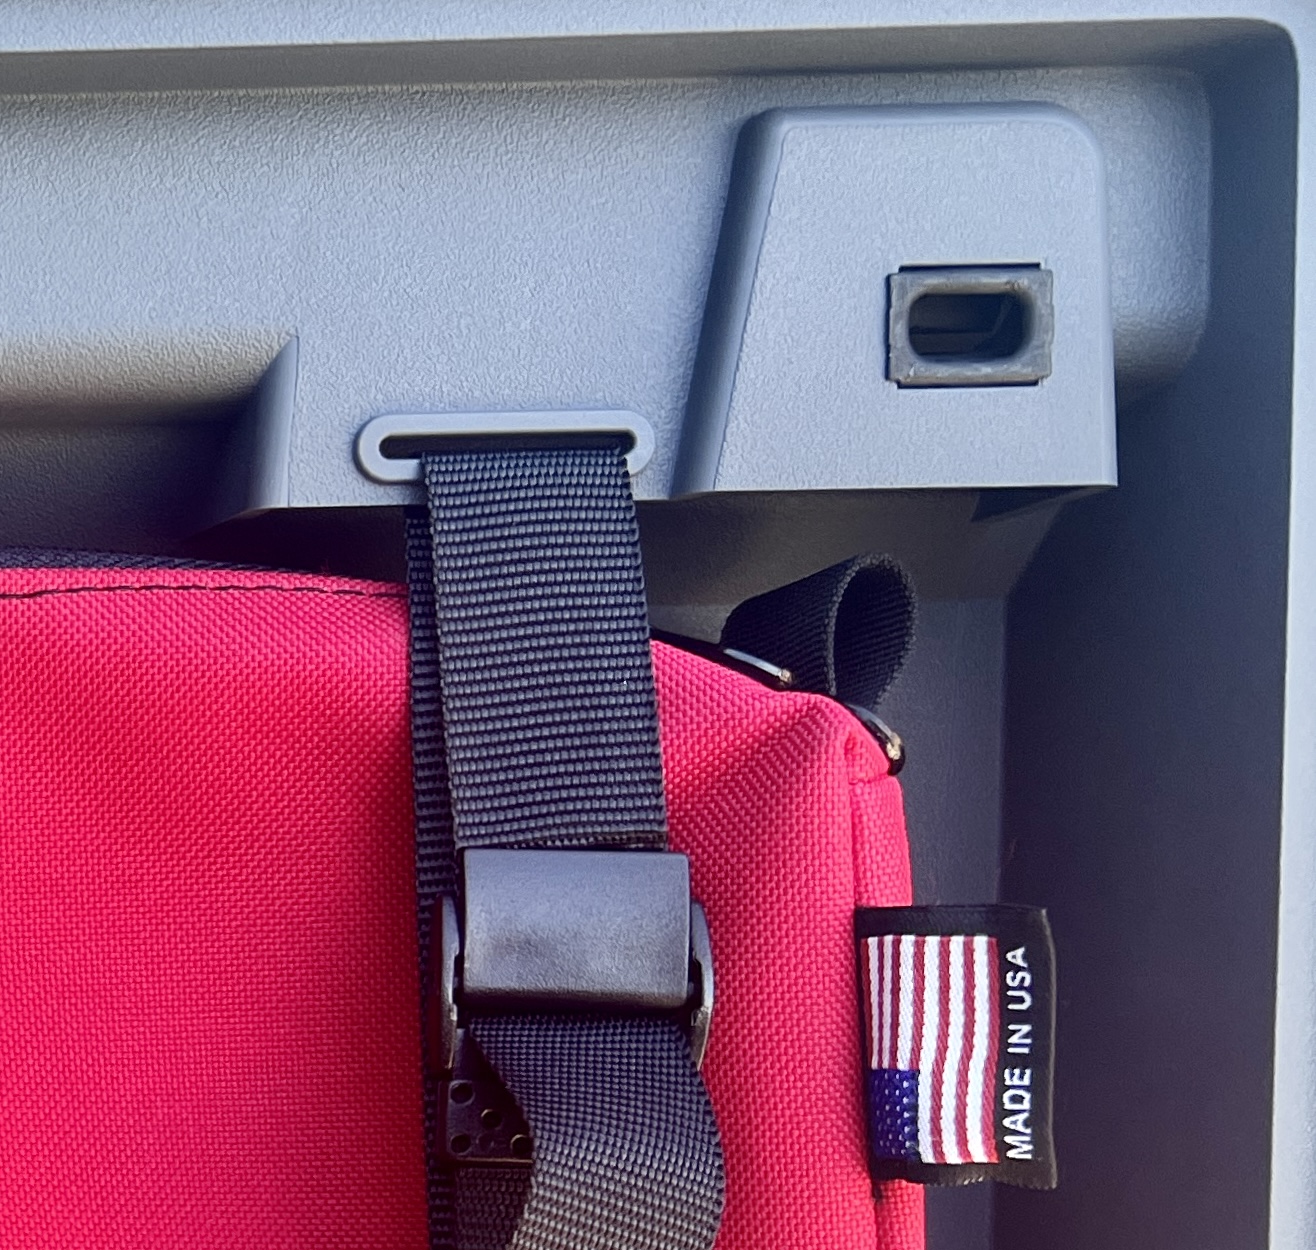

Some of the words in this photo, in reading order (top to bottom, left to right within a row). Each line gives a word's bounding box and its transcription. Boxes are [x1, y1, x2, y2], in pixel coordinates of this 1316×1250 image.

[1005, 946, 1033, 1011] USA
[1006, 1024, 1033, 1054] IN
[1002, 1068, 1033, 1160] MADE
